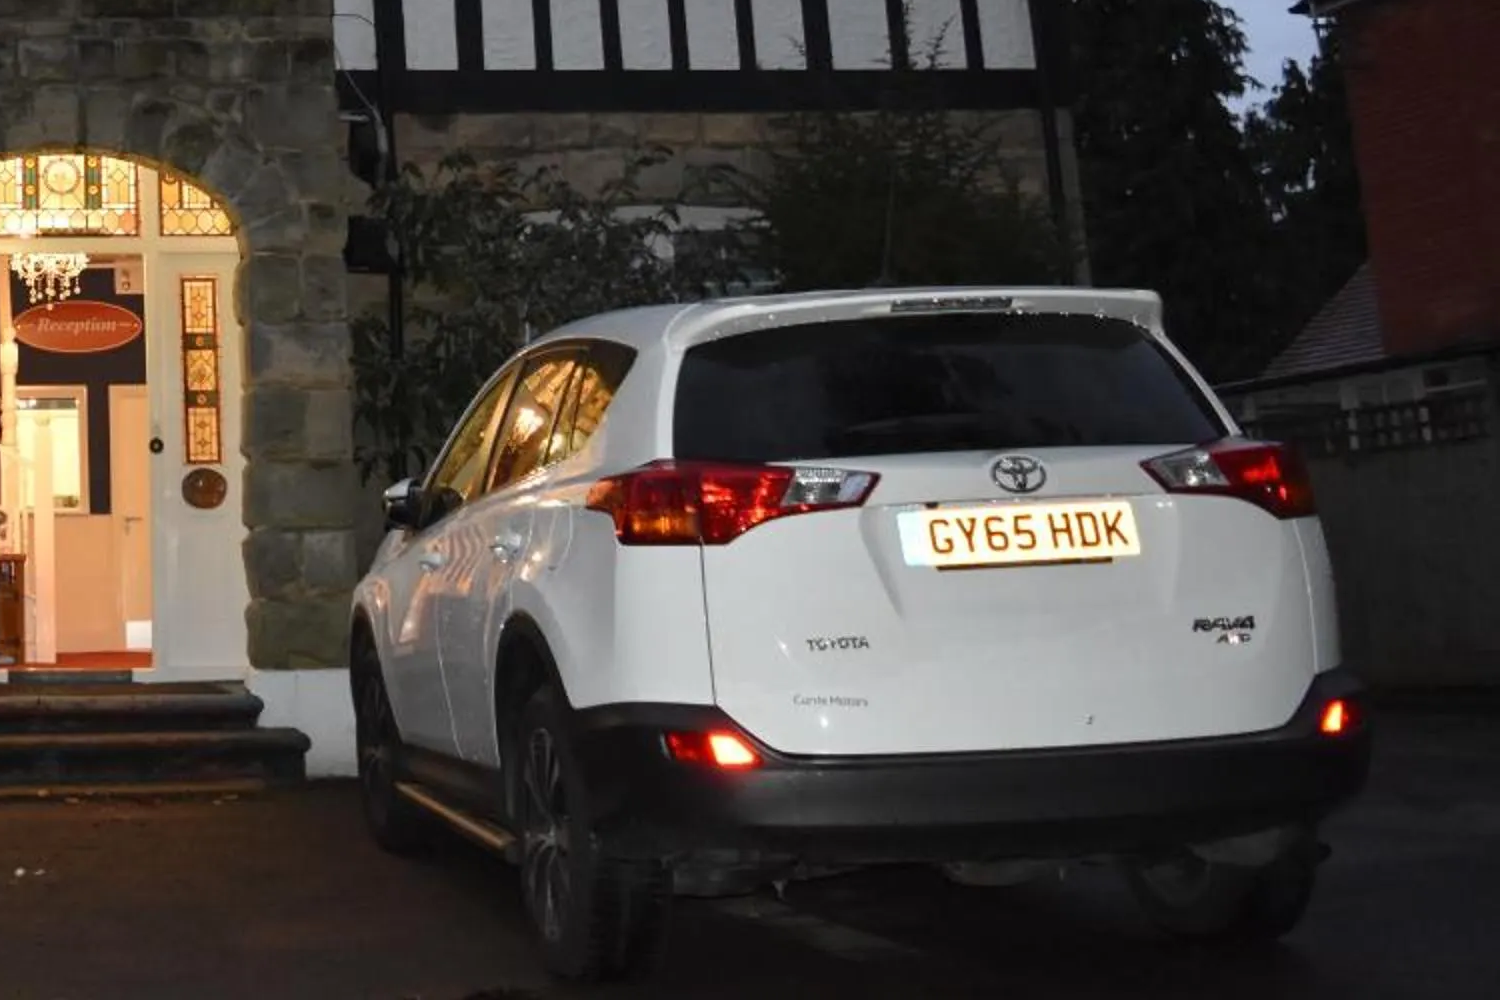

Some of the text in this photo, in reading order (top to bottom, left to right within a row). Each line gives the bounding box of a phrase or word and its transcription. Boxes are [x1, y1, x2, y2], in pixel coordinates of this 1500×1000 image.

[38, 317, 117, 337] Reception
[929, 509, 1129, 554] GY65 HDK
[805, 635, 869, 651] TOYOTA
